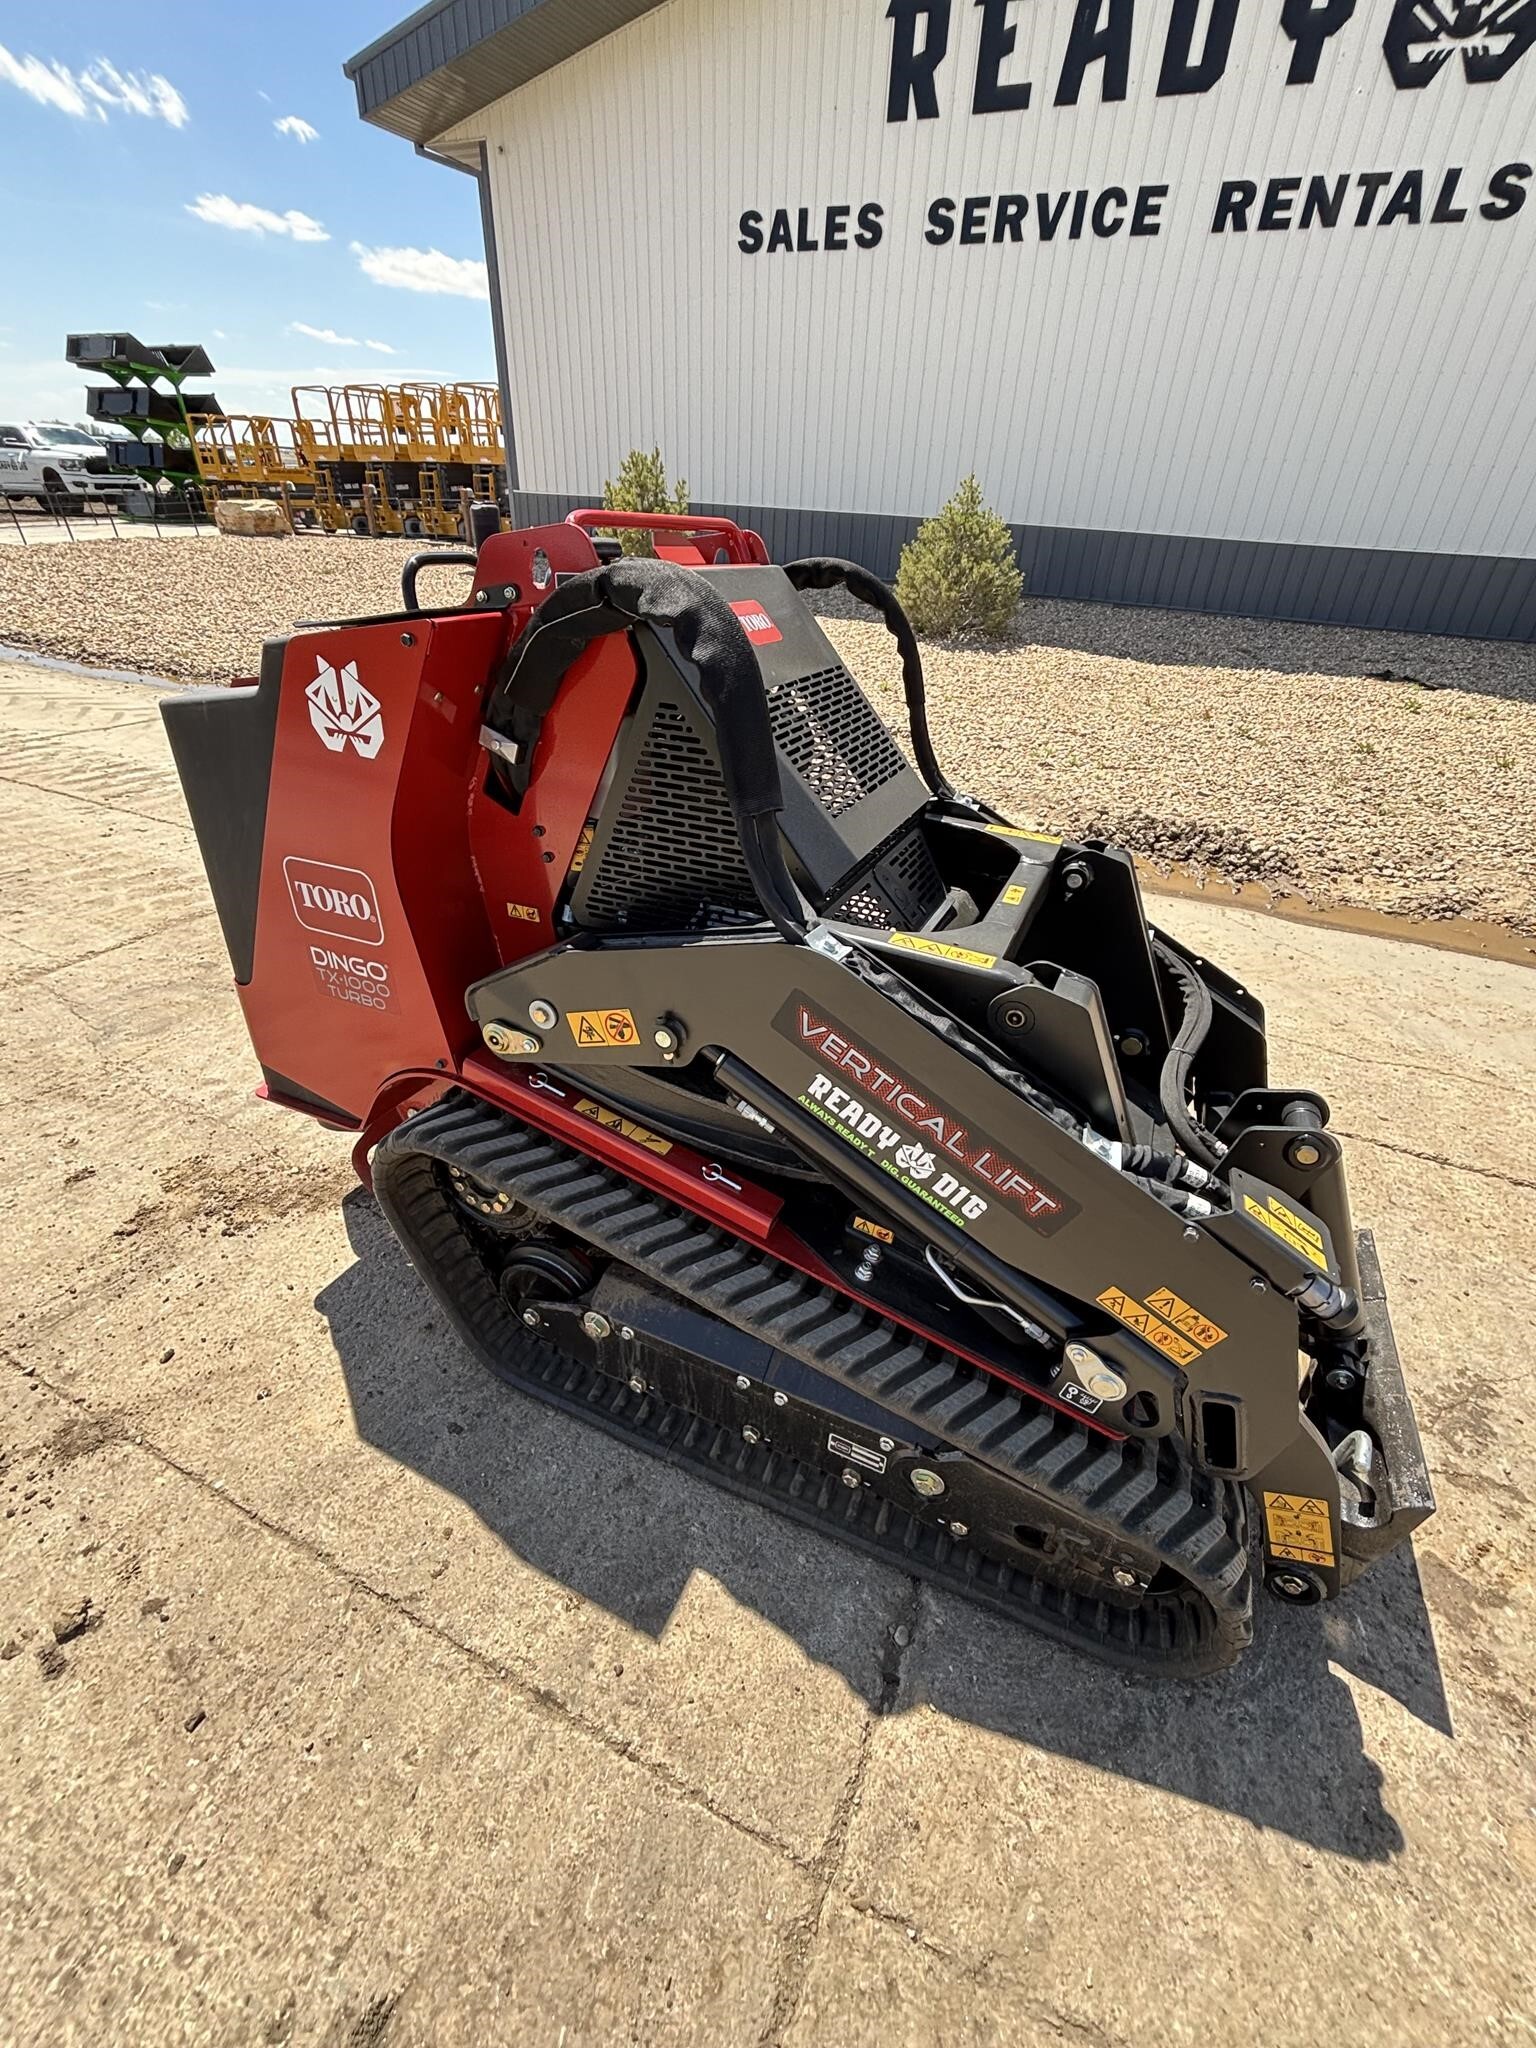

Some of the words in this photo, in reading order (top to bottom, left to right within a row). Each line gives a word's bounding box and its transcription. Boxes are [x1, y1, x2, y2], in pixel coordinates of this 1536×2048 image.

[886, 0, 1356, 123] READY
[738, 201, 884, 255] SALES
[924, 184, 1169, 246] SERVICE
[1211, 162, 1533, 234] RENTALS
[310, 946, 387, 982] DINGO
[327, 984, 387, 1011] TURBO
[797, 1094, 837, 1127] ALWAYS
[834, 1123, 869, 1150] READY
[900, 1175, 966, 1228] GUARANTEED
[801, 1009, 966, 1159] VERTICAL
[972, 1151, 1058, 1215] LIFT
[807, 1073, 902, 1151] READY
[931, 1172, 989, 1220] DIG
